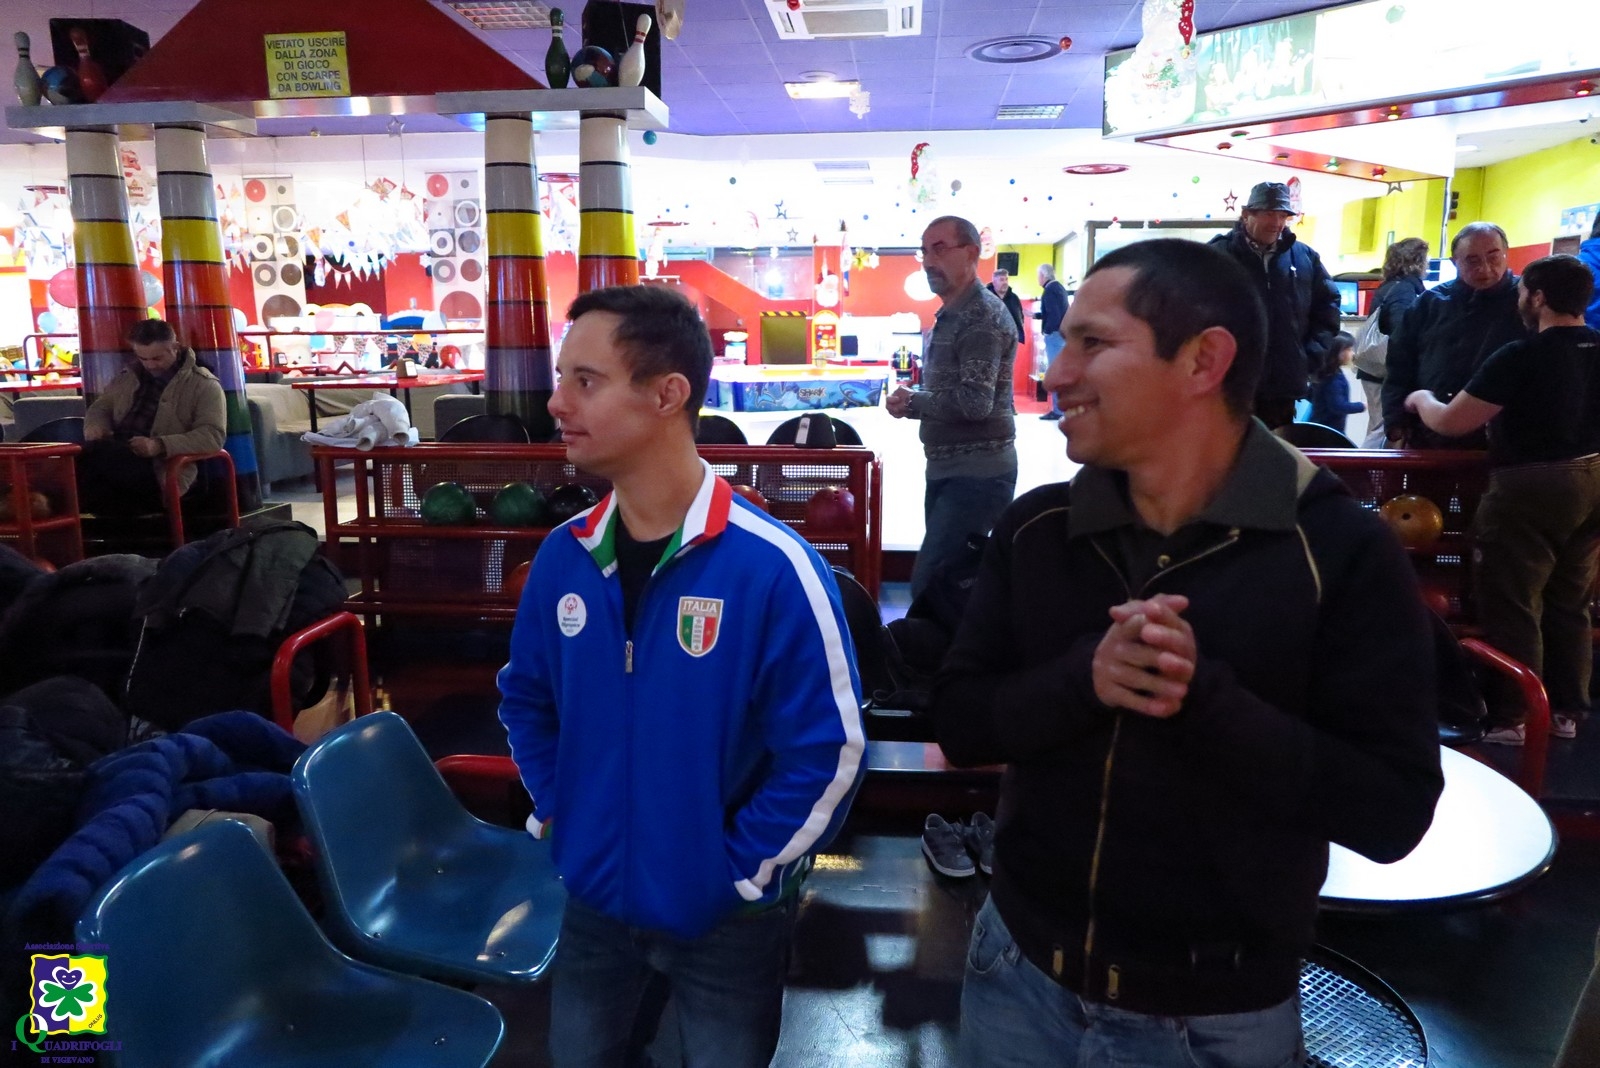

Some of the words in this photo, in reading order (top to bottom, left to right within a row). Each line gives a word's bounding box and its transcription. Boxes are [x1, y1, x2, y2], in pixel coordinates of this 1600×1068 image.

[266, 38, 305, 49] VIETATO
[308, 37, 345, 47] USCIRE
[275, 50, 307, 59] DALLA
[309, 48, 338, 58] ZONA
[284, 61, 294, 70] DI
[297, 60, 330, 69] GIOCO
[276, 72, 298, 81] CON
[301, 70, 341, 80] SCARPE
[278, 83, 292, 92] DA
[295, 81, 341, 92] BOWLING
[683, 600, 717, 613] ITALIA
